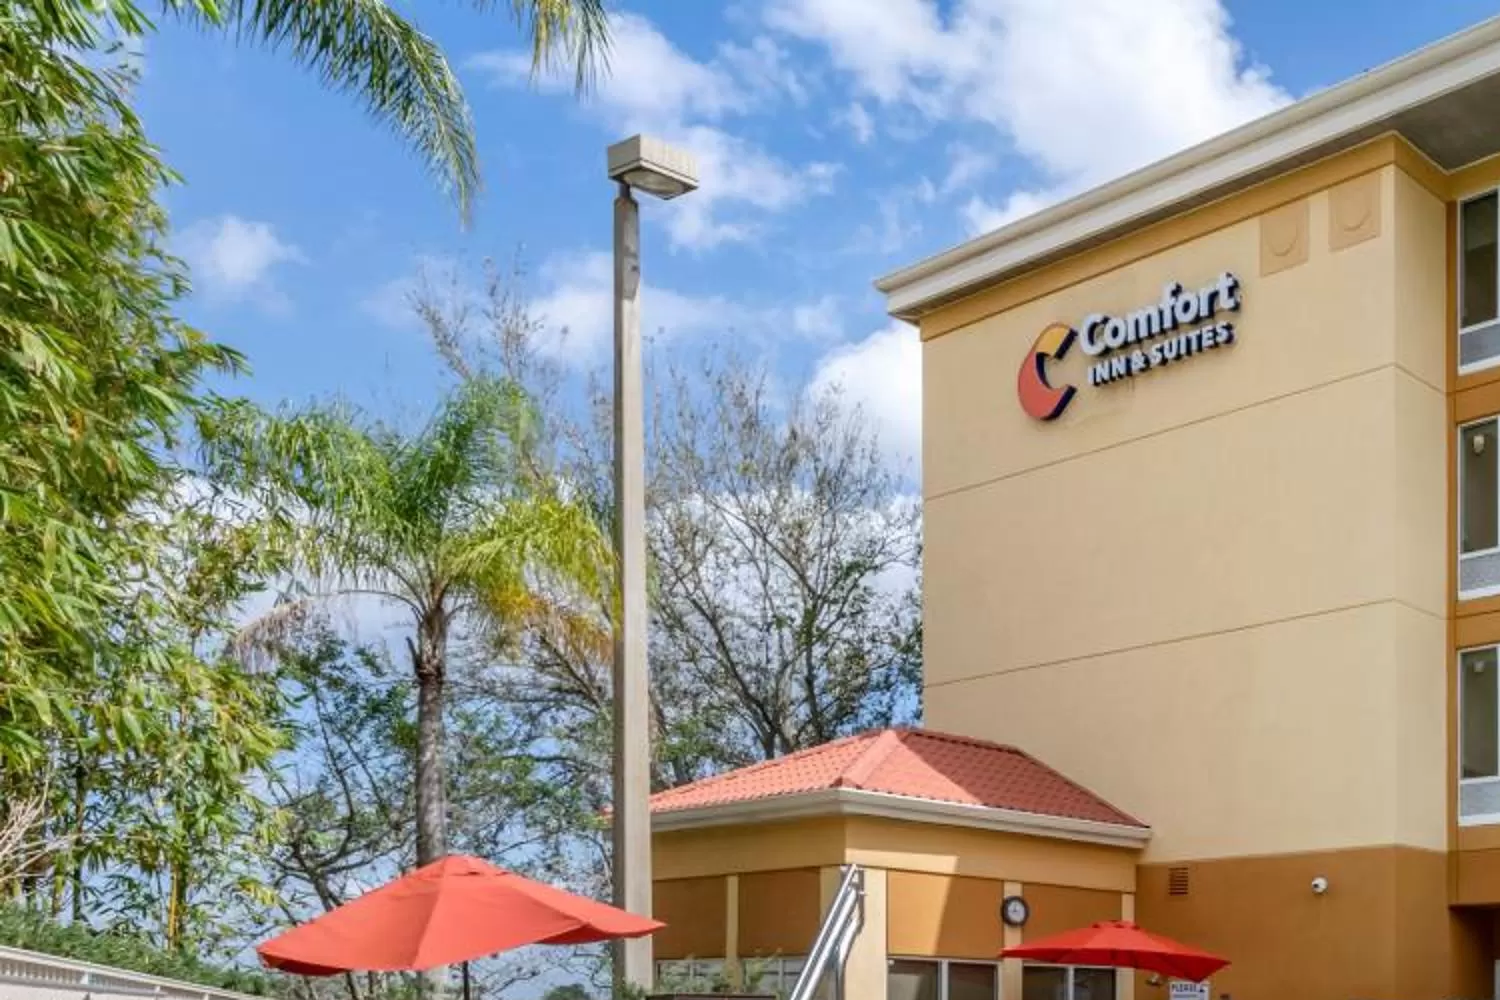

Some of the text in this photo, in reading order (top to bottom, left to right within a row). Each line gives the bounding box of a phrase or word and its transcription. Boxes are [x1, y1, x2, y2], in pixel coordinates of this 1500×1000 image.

[1079, 272, 1240, 356] Comfort
[1088, 321, 1235, 386] INN & SUITES
